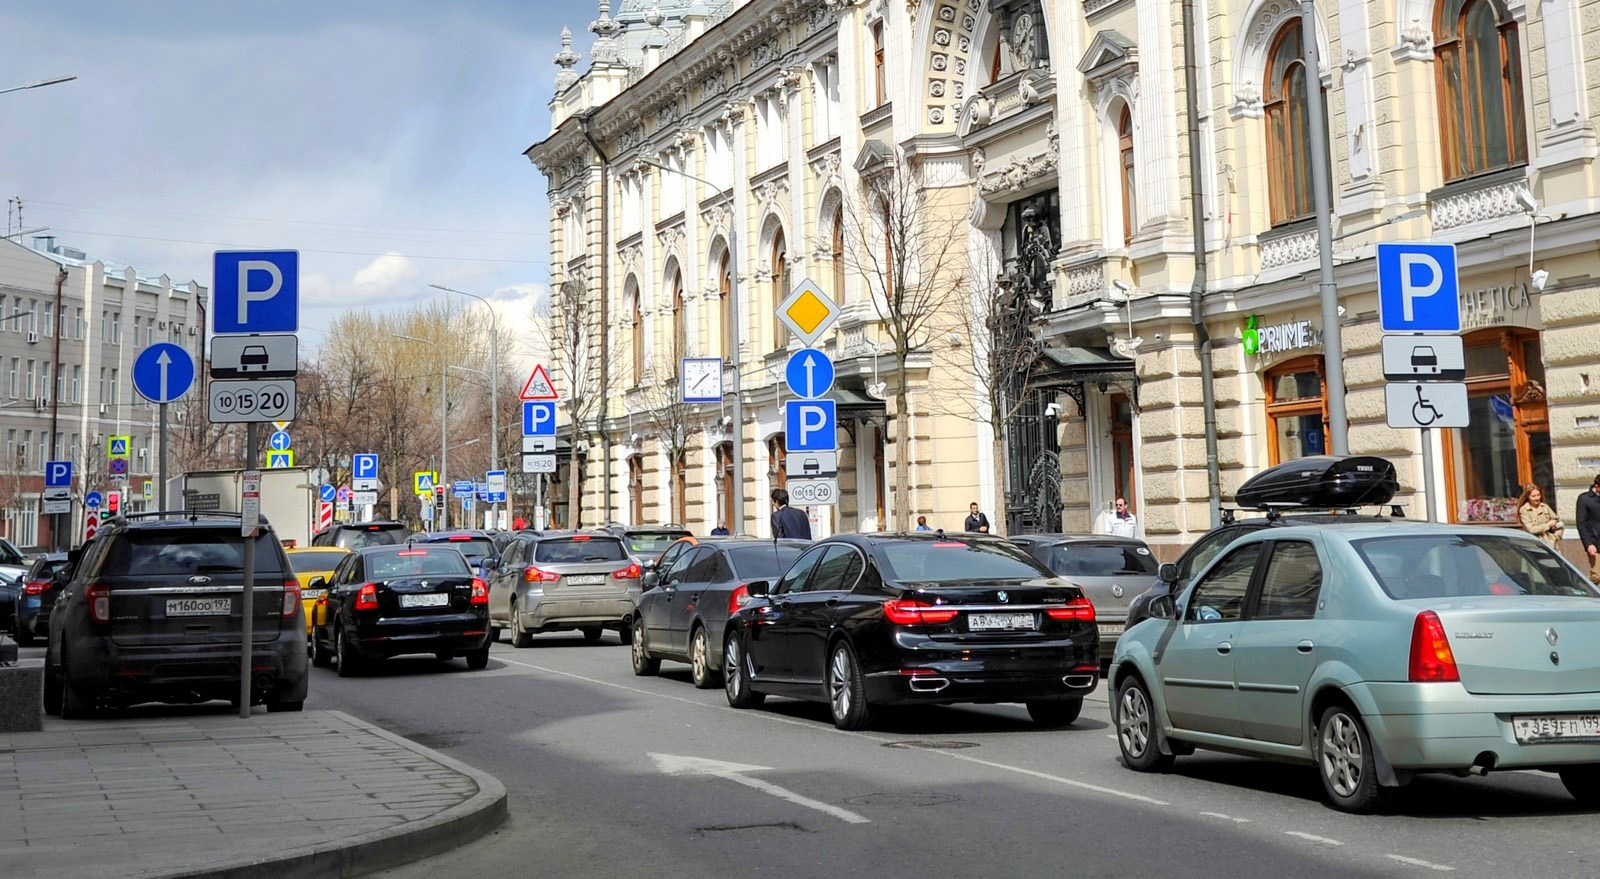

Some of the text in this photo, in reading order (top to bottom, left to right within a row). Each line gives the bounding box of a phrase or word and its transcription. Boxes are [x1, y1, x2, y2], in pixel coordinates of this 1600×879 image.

[238, 260, 283, 324] P
[1400, 252, 1443, 322] P
[1257, 320, 1311, 353] PRIME
[219, 392, 285, 410] 10 15 20
[532, 404, 551, 433] P
[799, 405, 827, 446] P
[52, 463, 67, 485] P
[360, 456, 374, 477] P
[542, 459, 553, 468] 20
[794, 487, 829, 497] 10 15 20
[213, 599, 229, 608] 197
